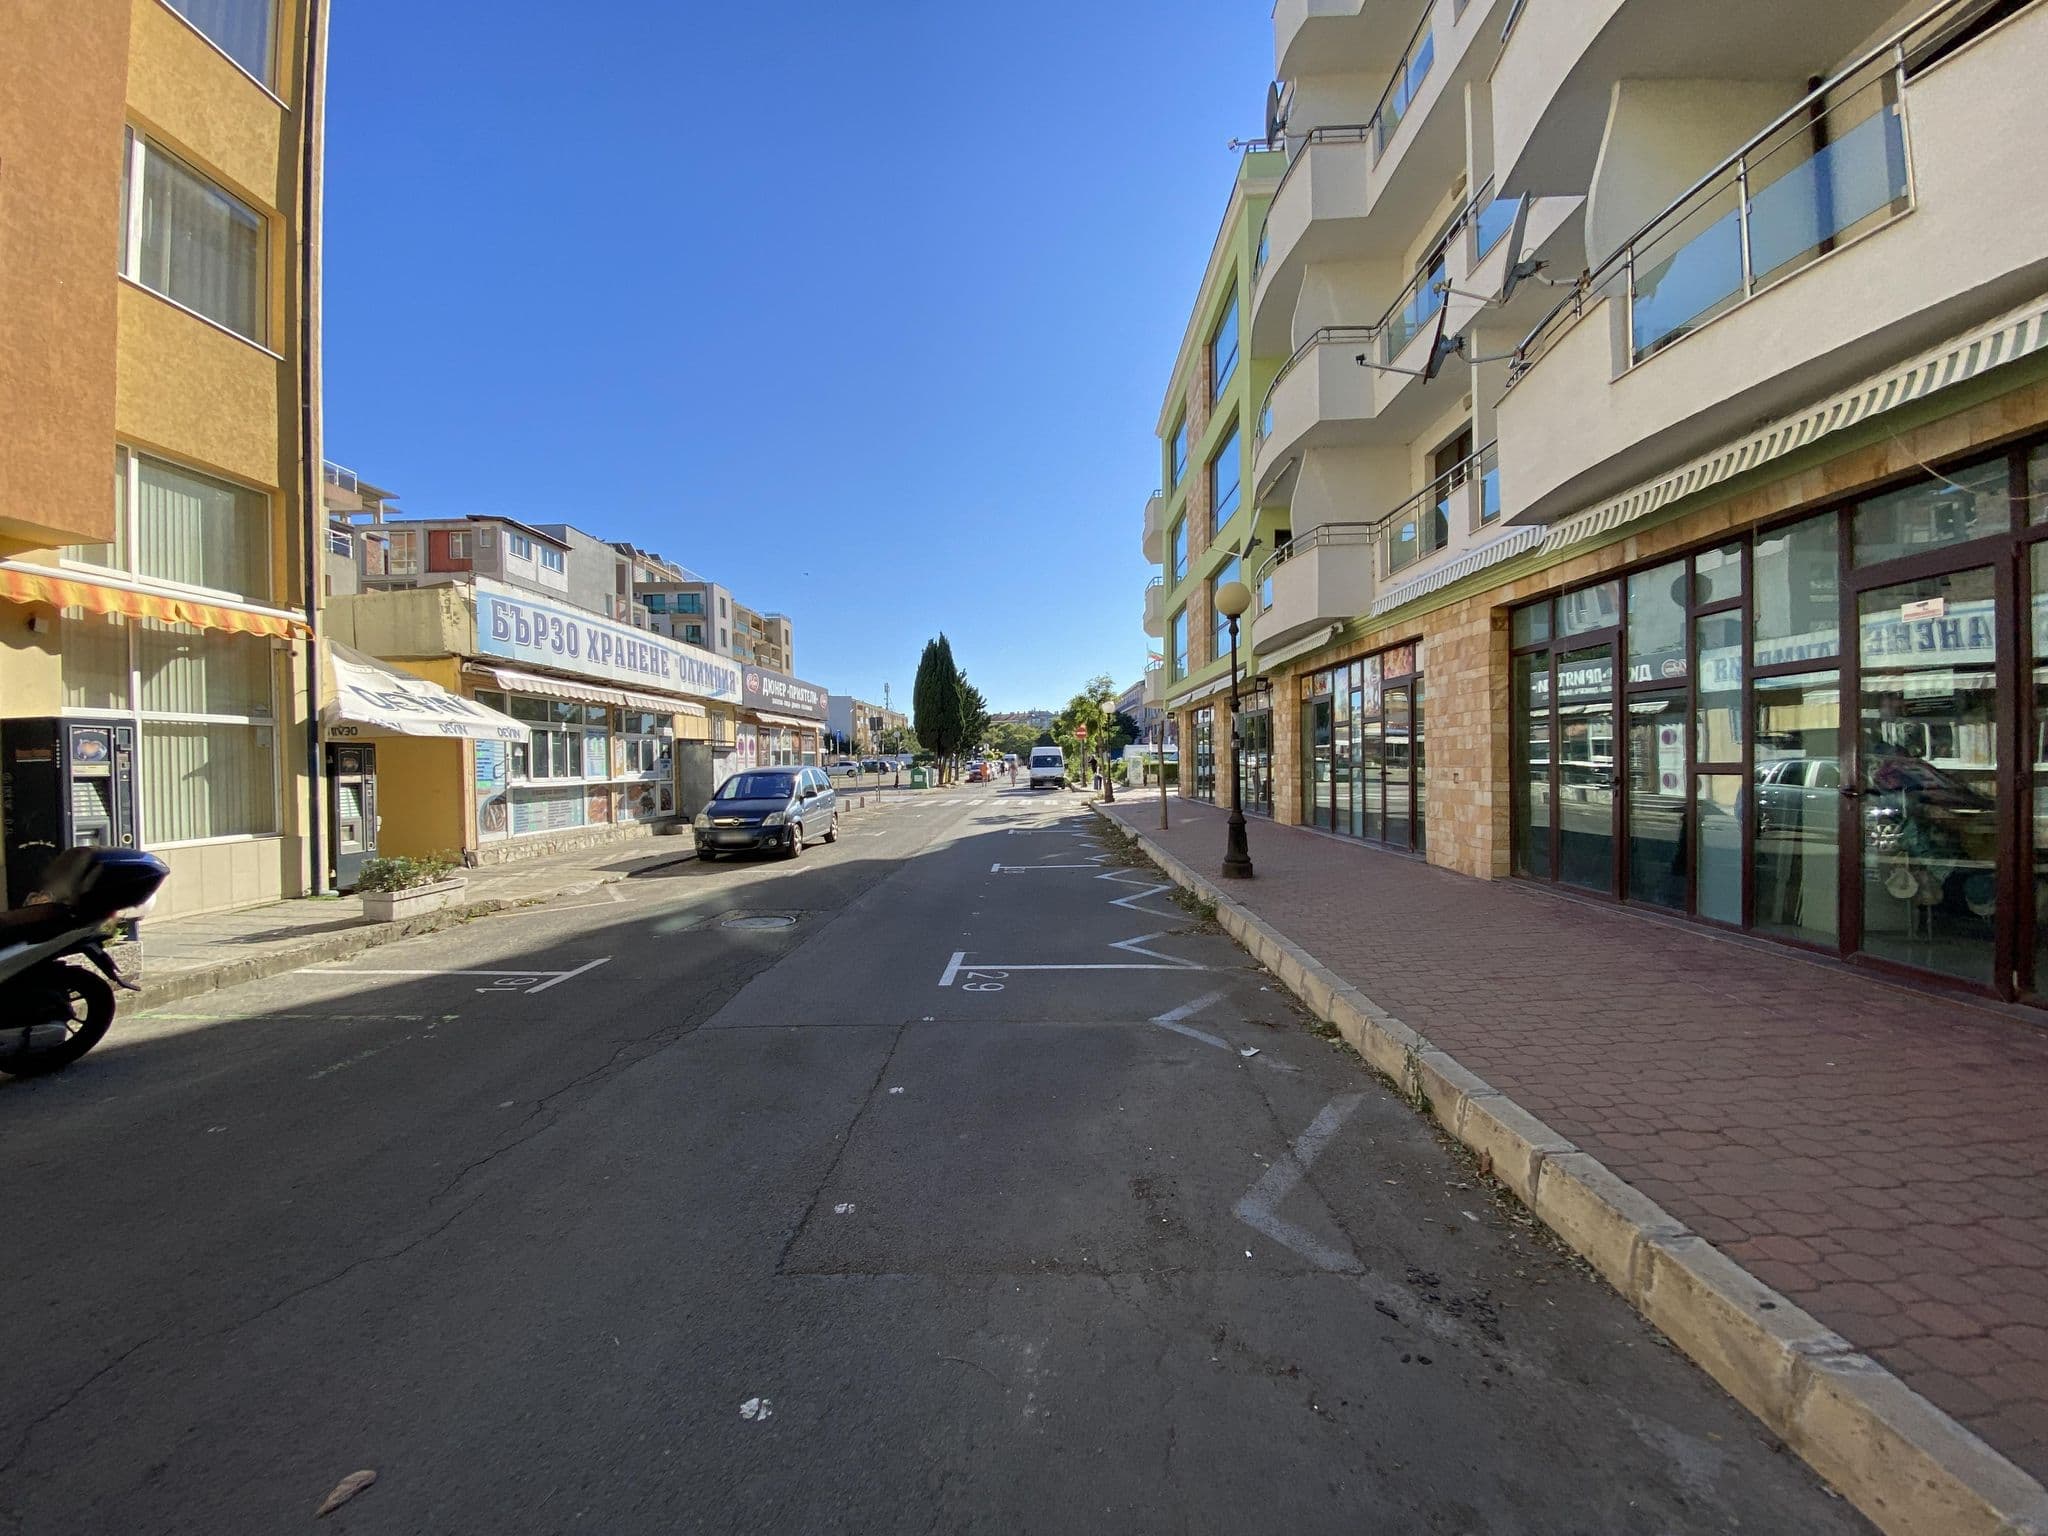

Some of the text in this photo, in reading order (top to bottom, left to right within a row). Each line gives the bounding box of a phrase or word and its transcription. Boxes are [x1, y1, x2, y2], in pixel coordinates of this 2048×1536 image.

[491, 598, 580, 658] БЪРЗО
[586, 628, 671, 679] ХРАНЕНЕ
[763, 677, 787, 698] ДЮНЕР
[438, 719, 469, 735] DEVIN
[496, 725, 520, 738] DEVIN
[961, 970, 1010, 992] 29
